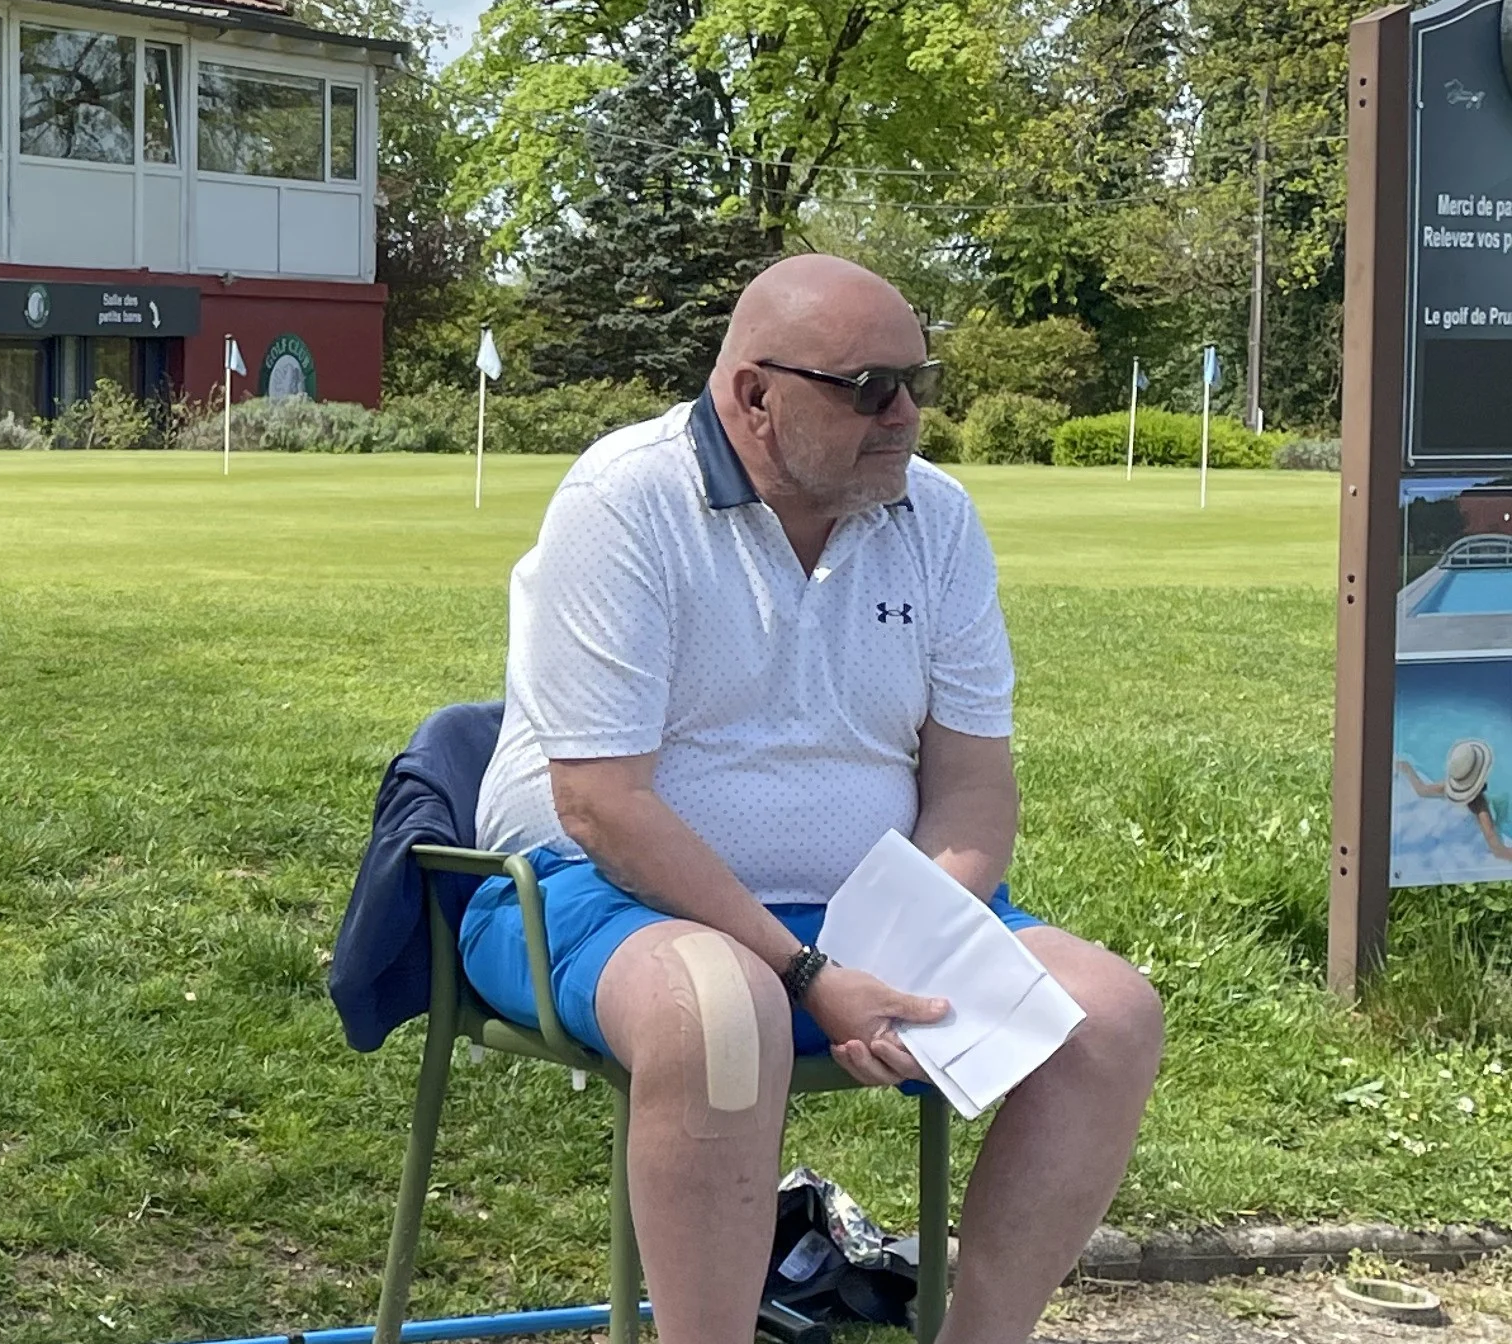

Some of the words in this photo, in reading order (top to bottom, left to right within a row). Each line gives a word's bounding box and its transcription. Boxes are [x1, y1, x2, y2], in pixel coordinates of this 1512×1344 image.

[1437, 194, 1475, 216] Merci
[1476, 195, 1493, 216] de
[1423, 225, 1475, 248] Relevez
[1477, 232, 1500, 248] vos
[1424, 306, 1440, 325] Le
[1443, 306, 1470, 330] golf
[1470, 306, 1487, 325] de
